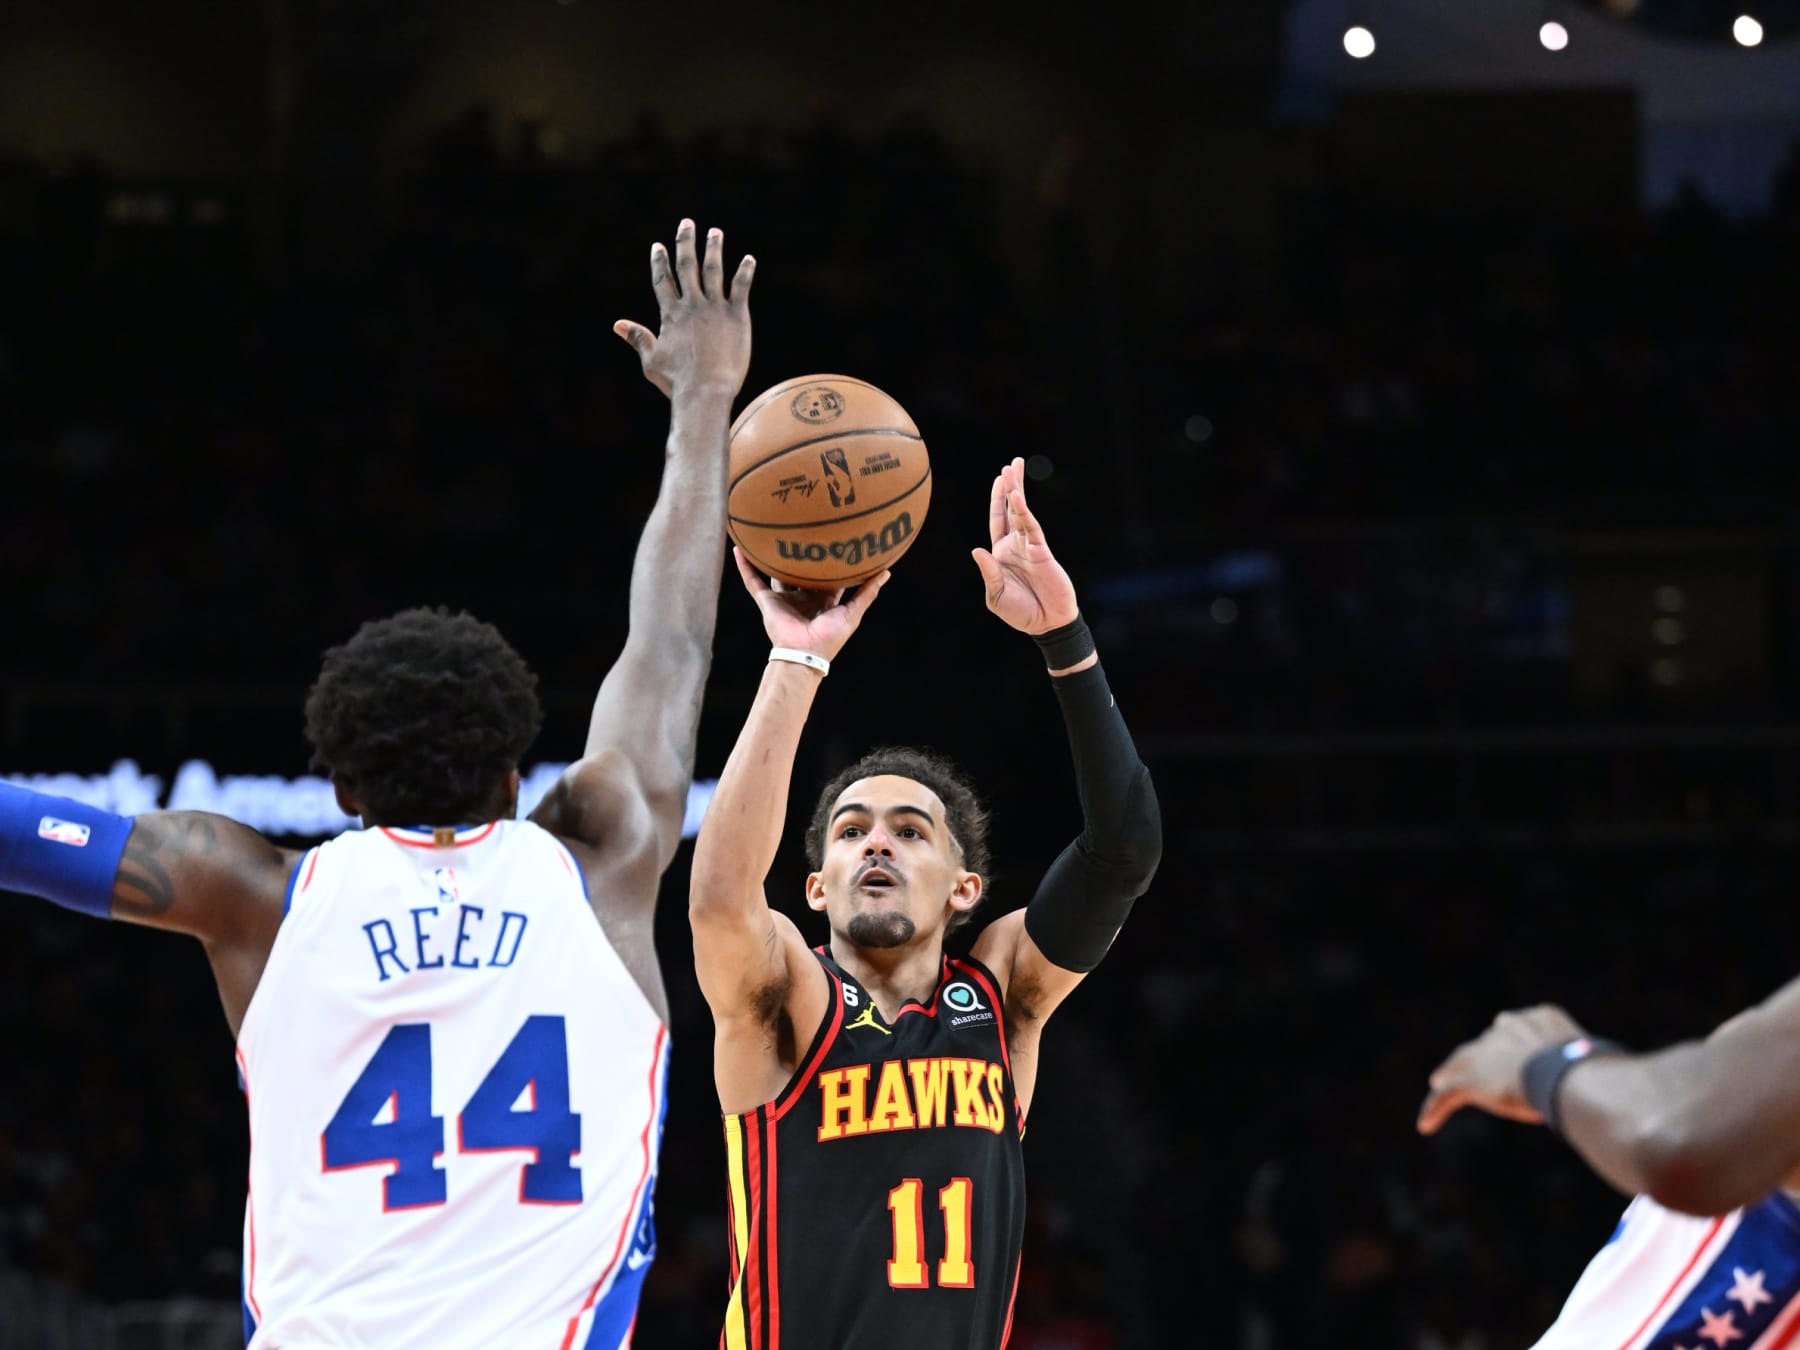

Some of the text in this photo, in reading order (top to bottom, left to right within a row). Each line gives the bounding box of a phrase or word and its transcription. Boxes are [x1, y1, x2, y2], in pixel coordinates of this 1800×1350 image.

[776, 511, 914, 565] Wilson
[362, 904, 528, 982] REED
[842, 982, 859, 1007] 6
[951, 1012, 993, 1026] sharecare
[321, 1014, 583, 1213] 44
[817, 1057, 1005, 1143] HAWKS
[887, 1177, 975, 1289] 11
